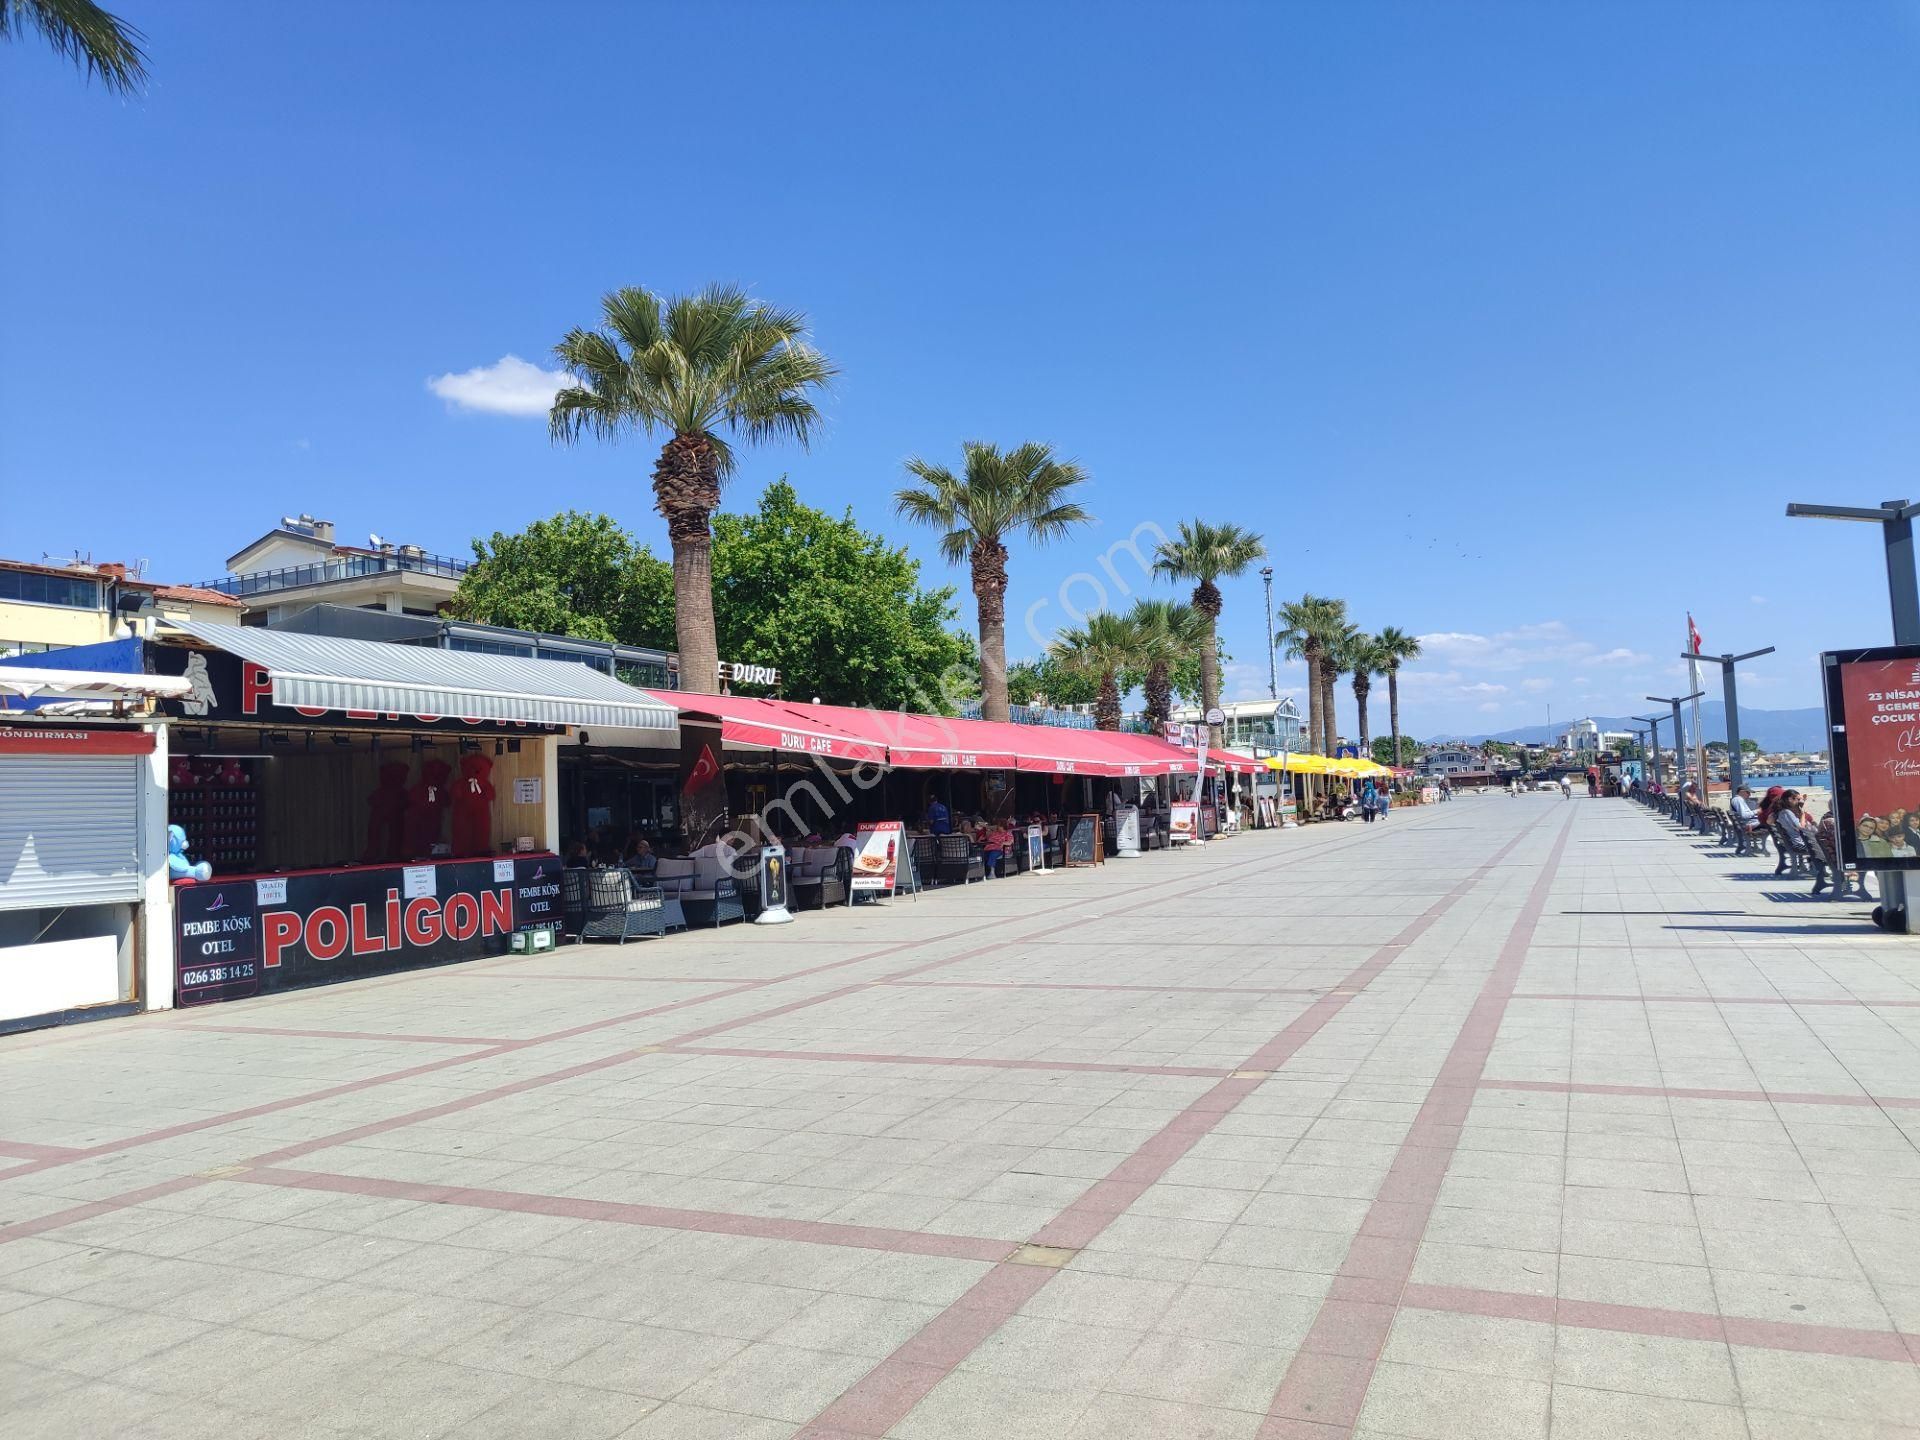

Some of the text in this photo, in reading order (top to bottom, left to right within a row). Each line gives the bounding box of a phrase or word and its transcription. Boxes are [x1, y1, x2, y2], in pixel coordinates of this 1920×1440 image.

[733, 663, 776, 685] DURU
[1868, 693, 1882, 701] 23
[1878, 702, 1920, 712] EGEME
[1872, 714, 1916, 725] ÇOCUK
[0, 731, 88, 740] ONDURMASI
[781, 733, 832, 753] DURU CAFE
[941, 754, 977, 766] DURU CAFE
[519, 883, 561, 898] PEMBE KÖŞK
[530, 902, 551, 912] OTEL
[183, 915, 252, 936] PEMBE KÖŞK
[262, 887, 514, 969] POLİGON
[202, 939, 236, 955] OTEL
[184, 963, 254, 985] 0266 385 14 25
